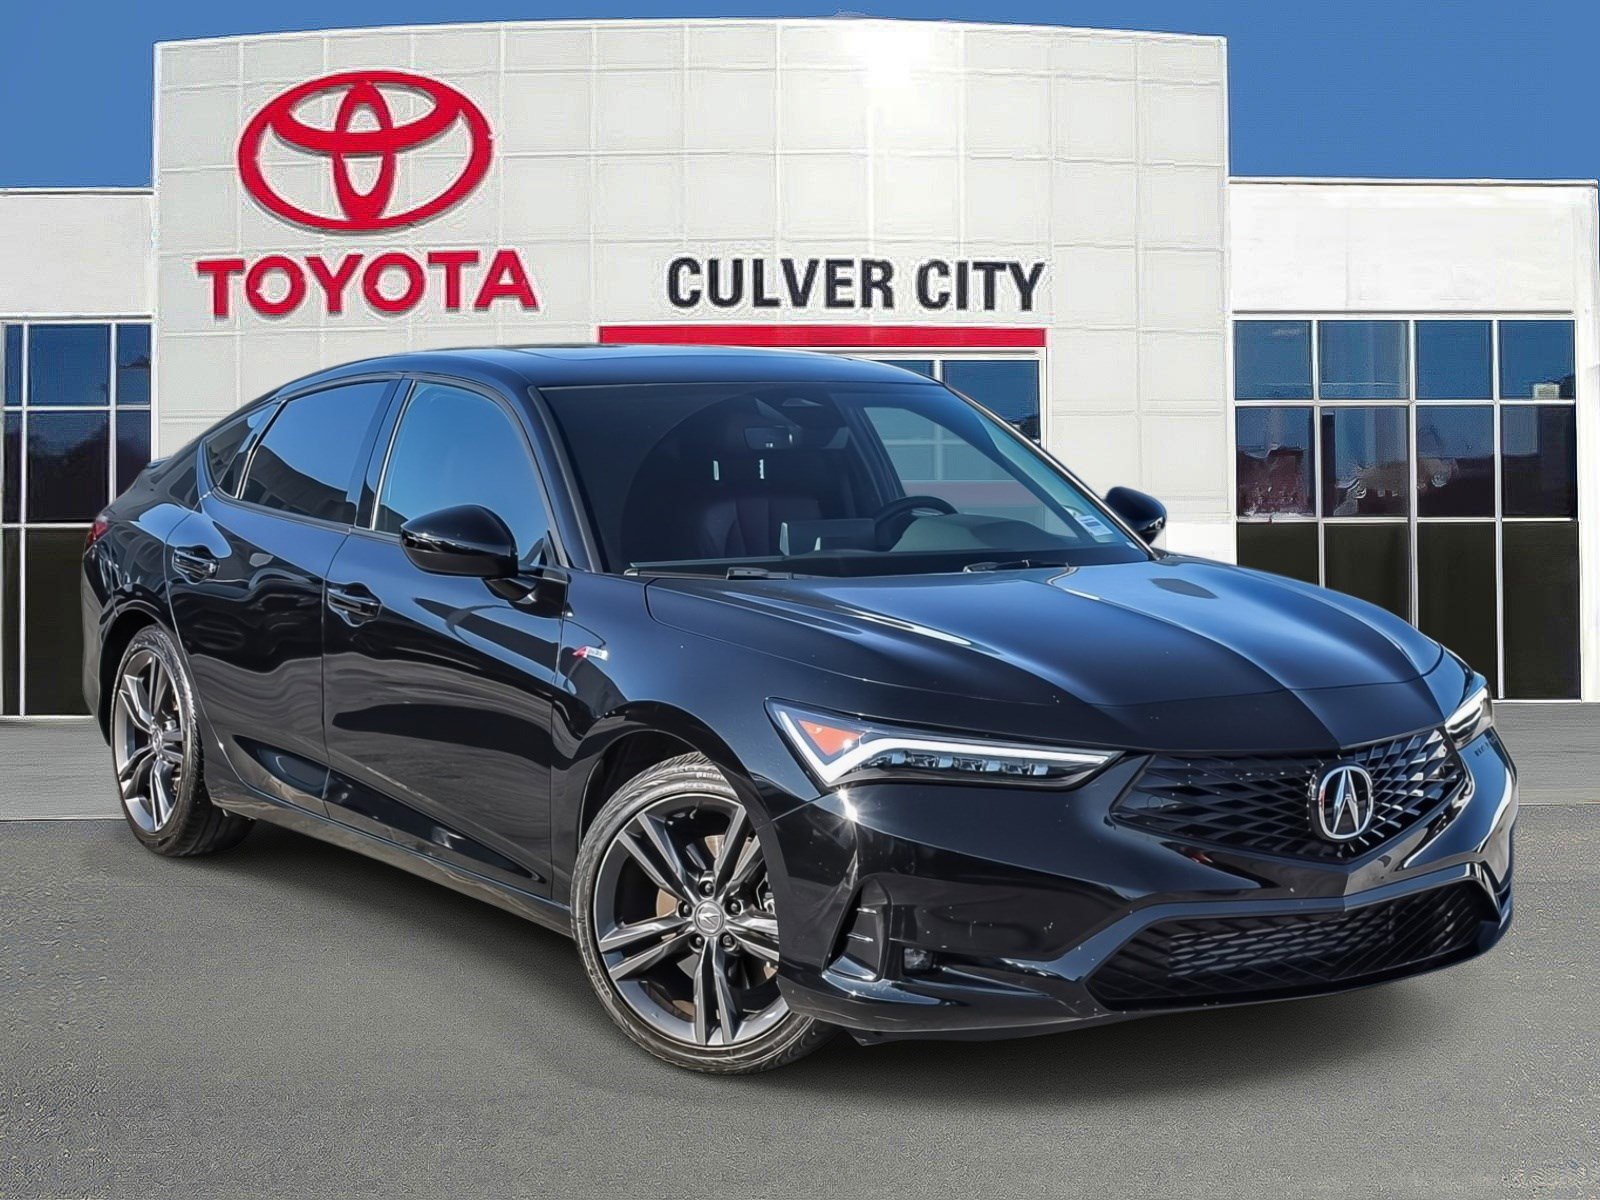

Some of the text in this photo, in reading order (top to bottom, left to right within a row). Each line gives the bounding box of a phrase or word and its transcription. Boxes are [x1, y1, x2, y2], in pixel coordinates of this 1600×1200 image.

[195, 249, 538, 319] TOYOTA
[668, 258, 1045, 310] CULVER CITY
